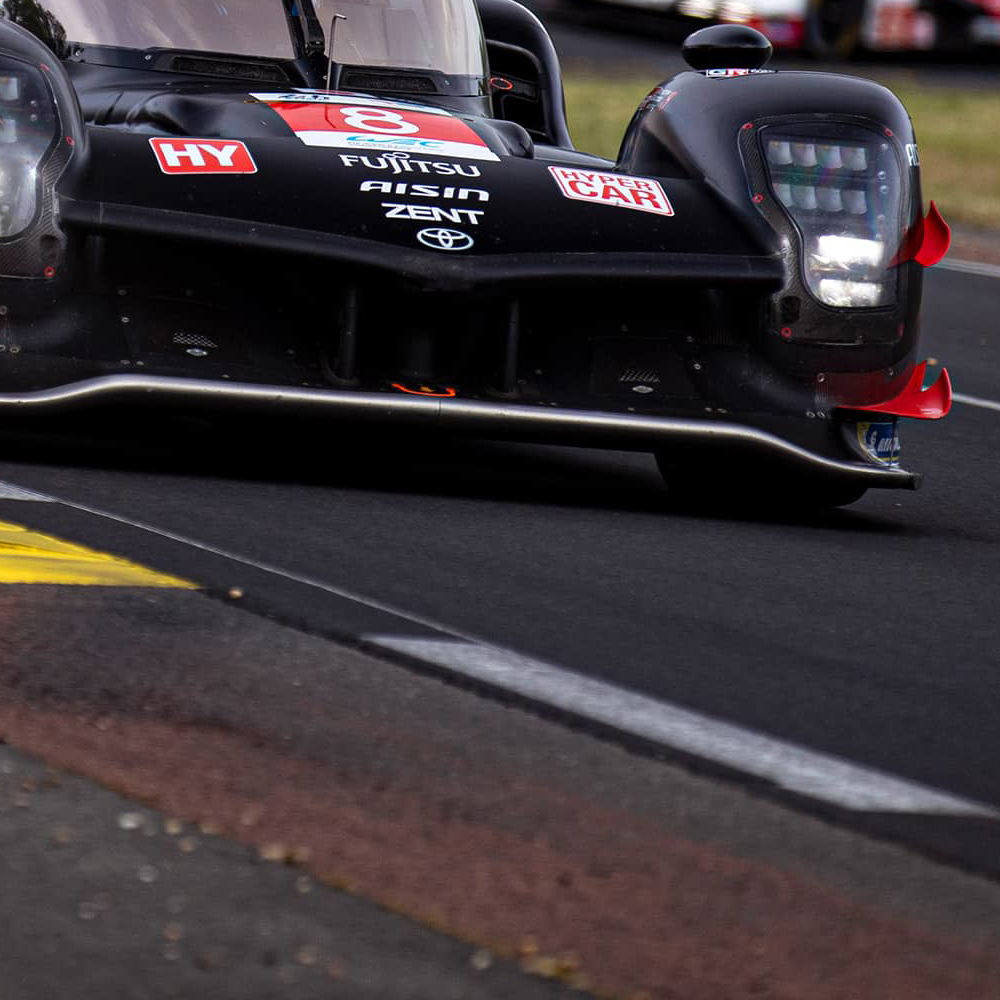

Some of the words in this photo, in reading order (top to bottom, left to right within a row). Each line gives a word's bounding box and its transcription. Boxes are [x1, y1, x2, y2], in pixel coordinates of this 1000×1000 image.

[339, 106, 420, 135] 8
[159, 143, 239, 167] HY
[338, 152, 482, 178] FUJITSU
[360, 180, 490, 202] AISIN
[560, 170, 653, 191] HYPER
[567, 180, 663, 209] CAR
[381, 202, 485, 225] ZENT
